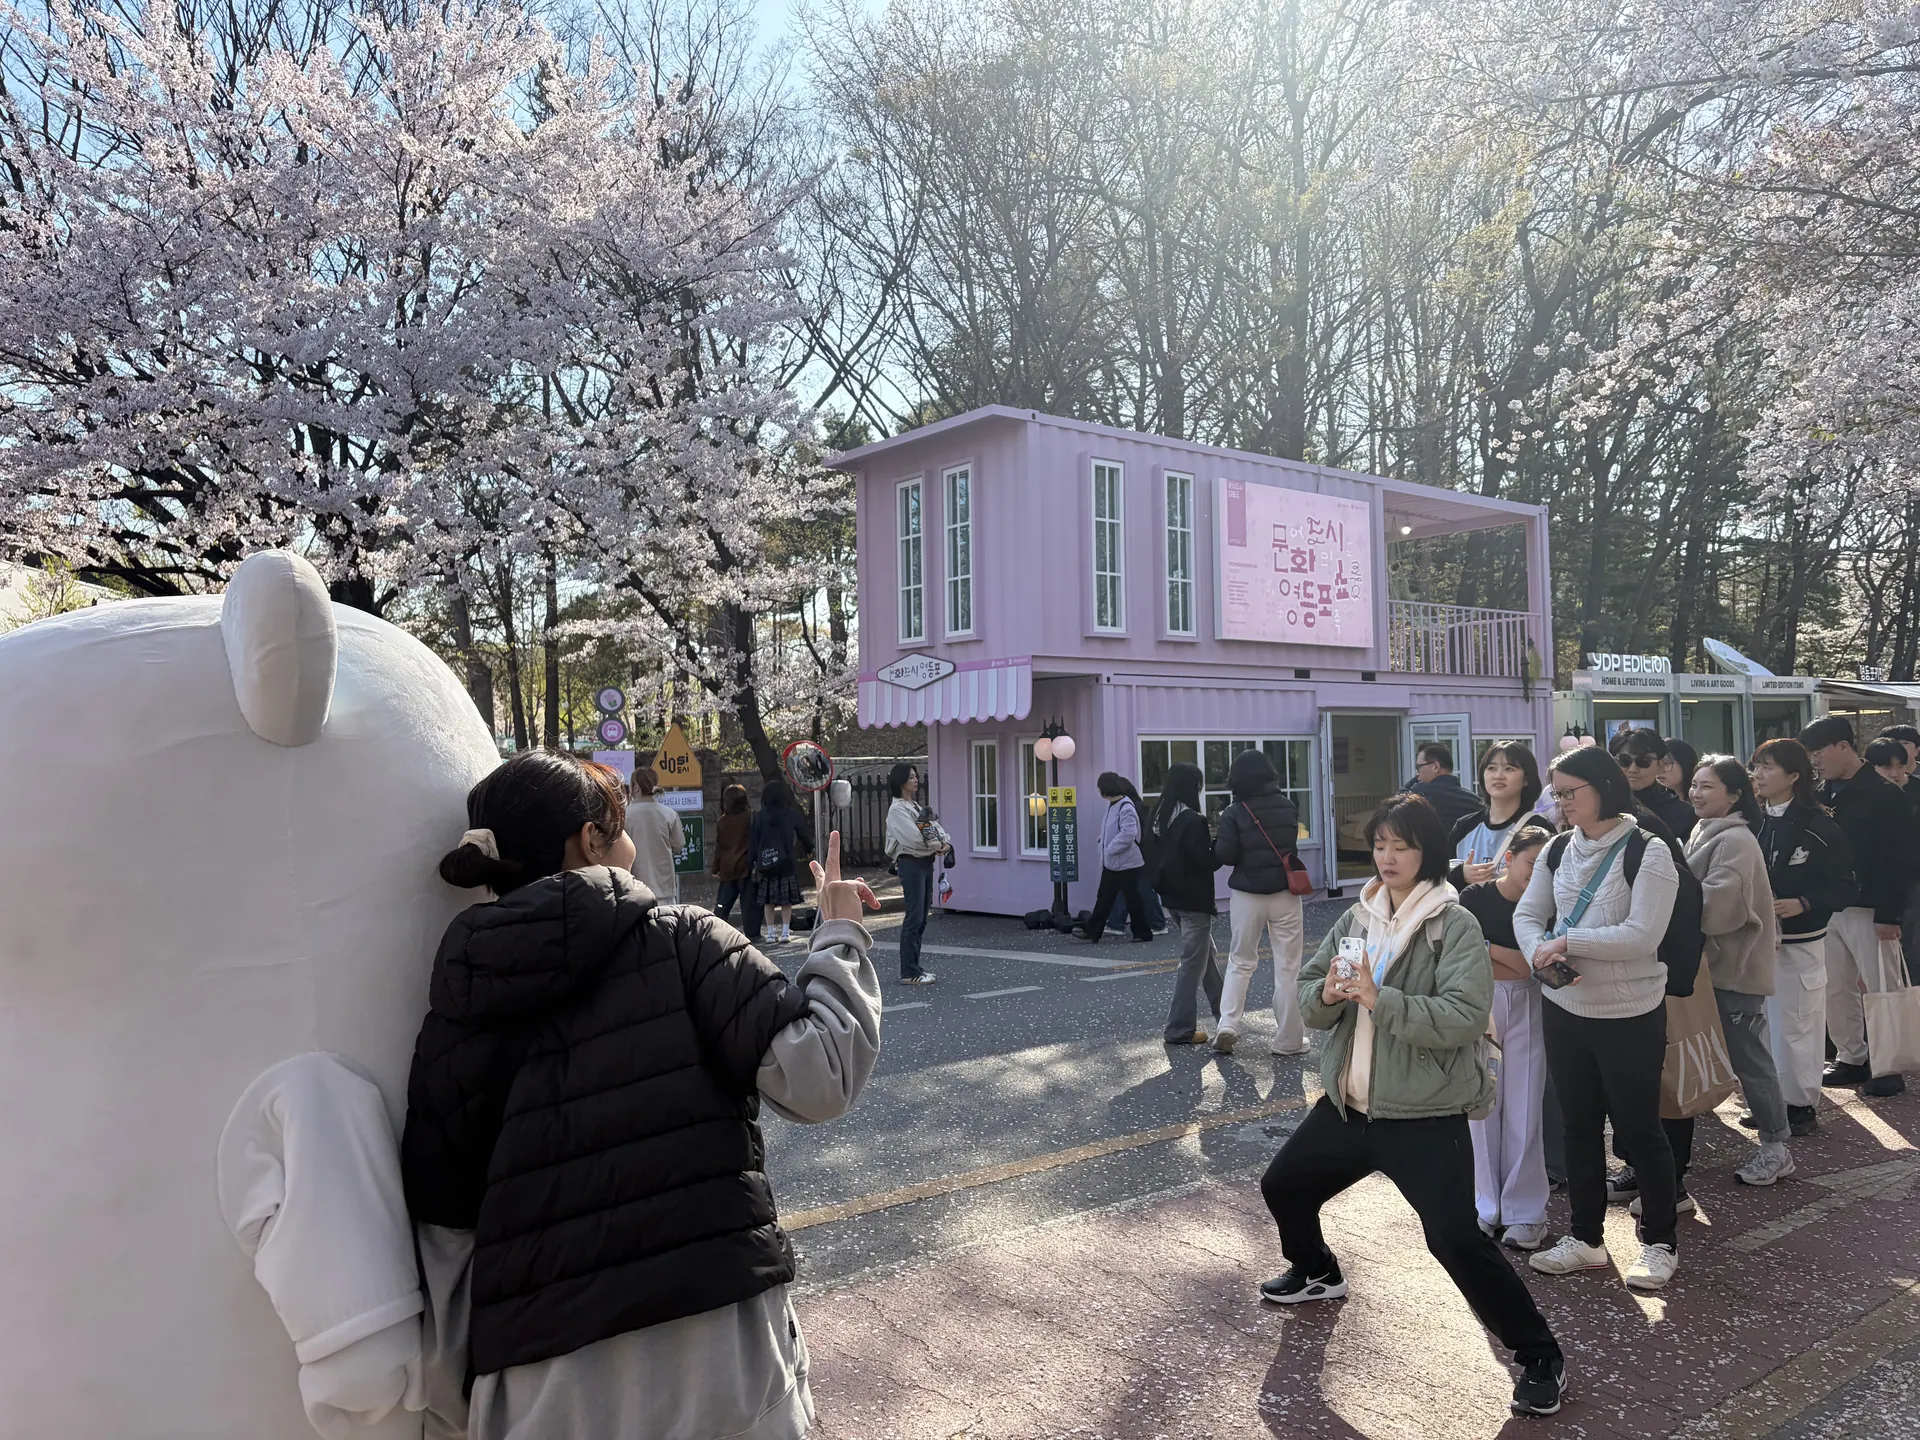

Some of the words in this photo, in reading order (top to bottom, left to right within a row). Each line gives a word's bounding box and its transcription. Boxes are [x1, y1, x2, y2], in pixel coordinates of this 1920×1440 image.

[1601, 677, 1617, 685] HOME
[1622, 677, 1648, 686] LIFESTYLE
[1649, 678, 1666, 687] GOODS
[1691, 680, 1706, 688] LIVING
[1711, 680, 1719, 688] ART
[1720, 680, 1735, 688] GOODS
[1762, 681, 1777, 689] LIMITED
[1778, 681, 1792, 689] EDITION
[1793, 681, 1804, 689] ITEMS
[1052, 808, 1057, 817] 2
[1066, 808, 1072, 817] 2
[1051, 823, 1060, 865] 영등포역
[1065, 823, 1075, 865] 영등포역
